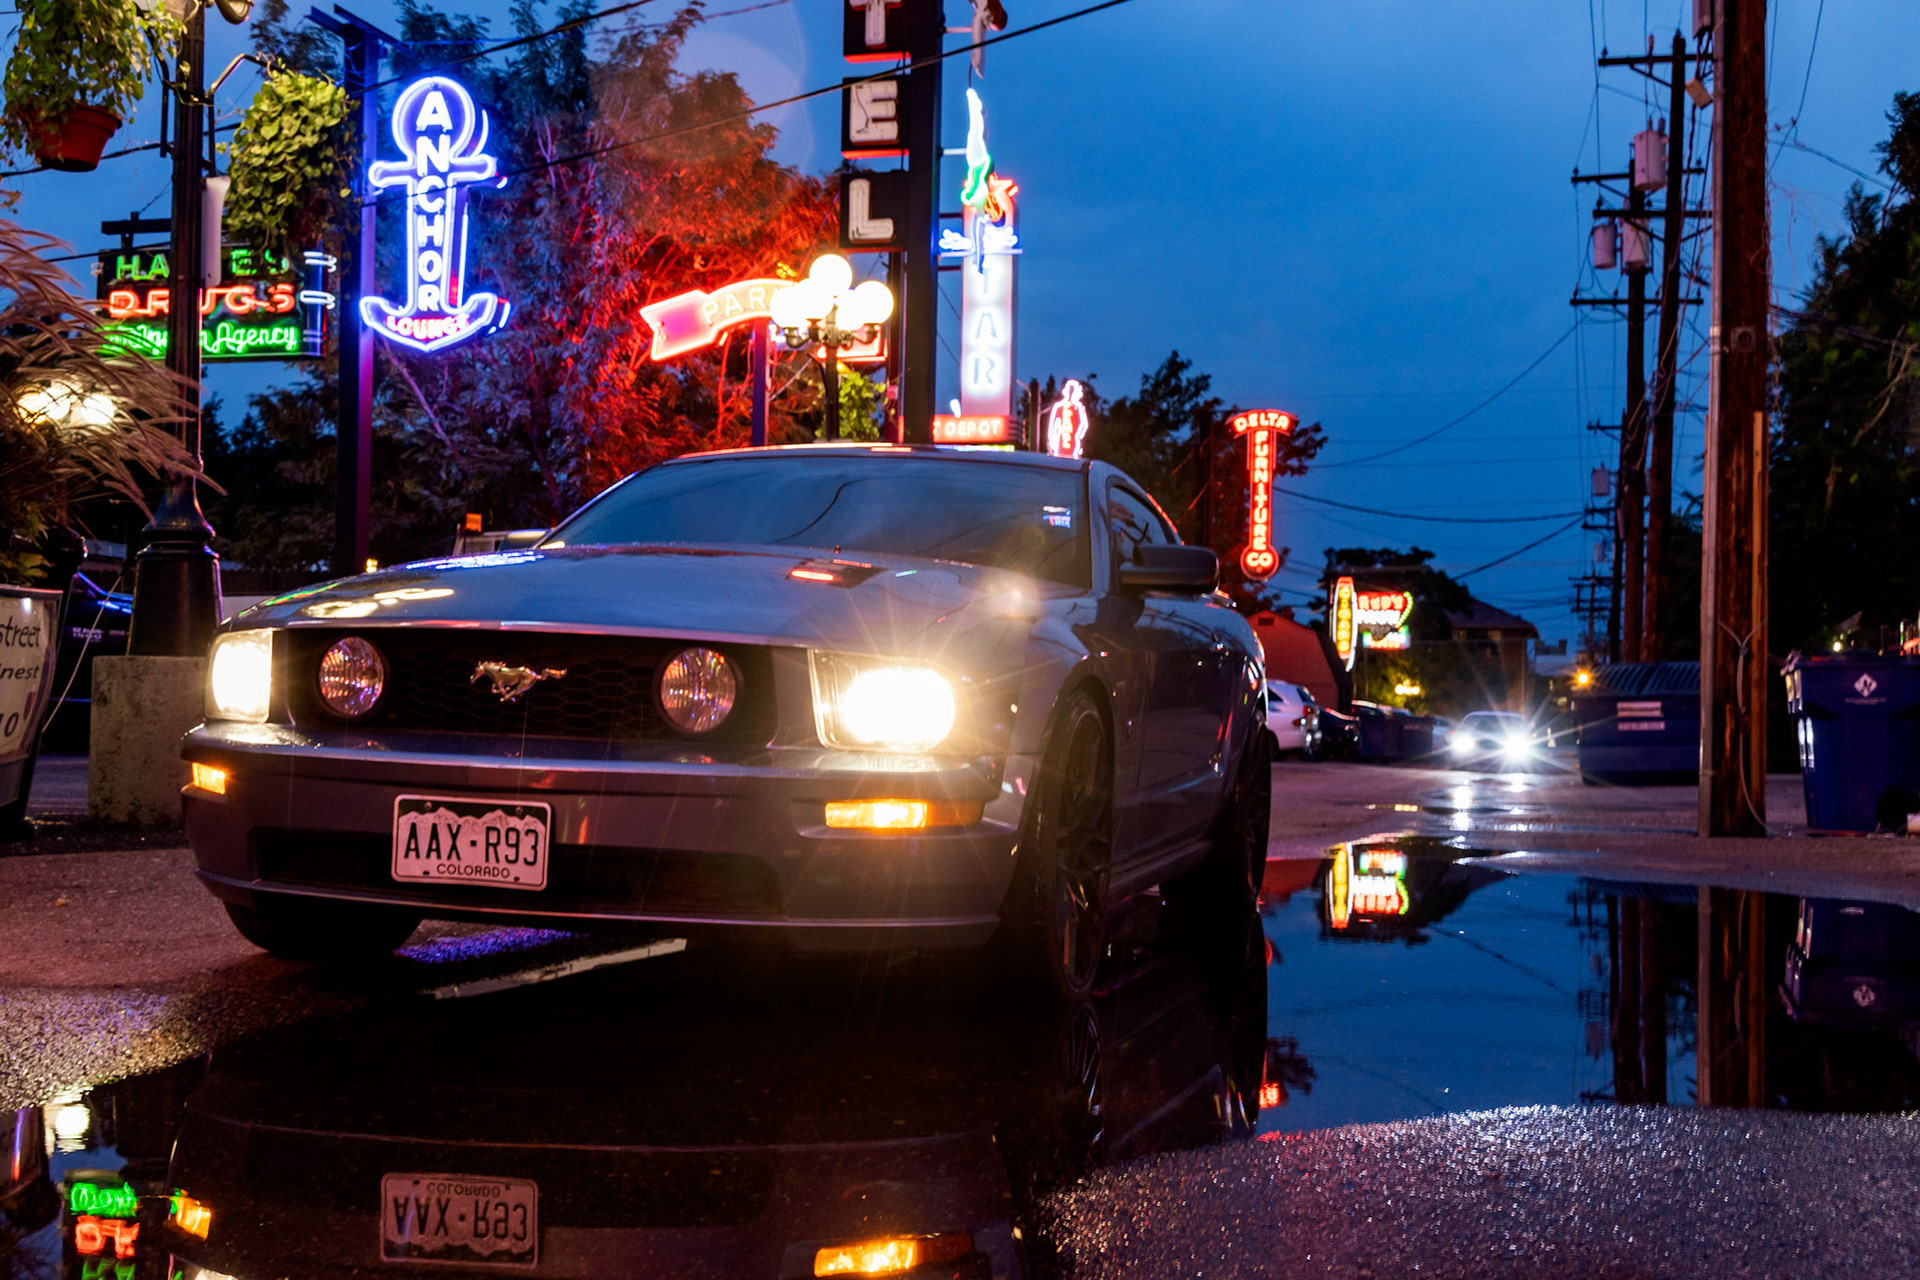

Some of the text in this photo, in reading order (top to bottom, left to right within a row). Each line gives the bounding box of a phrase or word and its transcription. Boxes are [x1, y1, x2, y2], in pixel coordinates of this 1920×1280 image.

[415, 91, 453, 312] ANCHOR
[702, 287, 777, 325] PAR
[213, 322, 298, 353] Agency
[386, 312, 469, 341] LOUNGE
[945, 420, 1000, 436] DEPOT
[1234, 412, 1289, 432] DELTA
[1253, 431, 1269, 550] FURNITURE
[0, 616, 41, 648] treet
[0, 665, 39, 680] nest
[0, 712, 20, 737] 0
[436, 863, 510, 879] COLORADO
